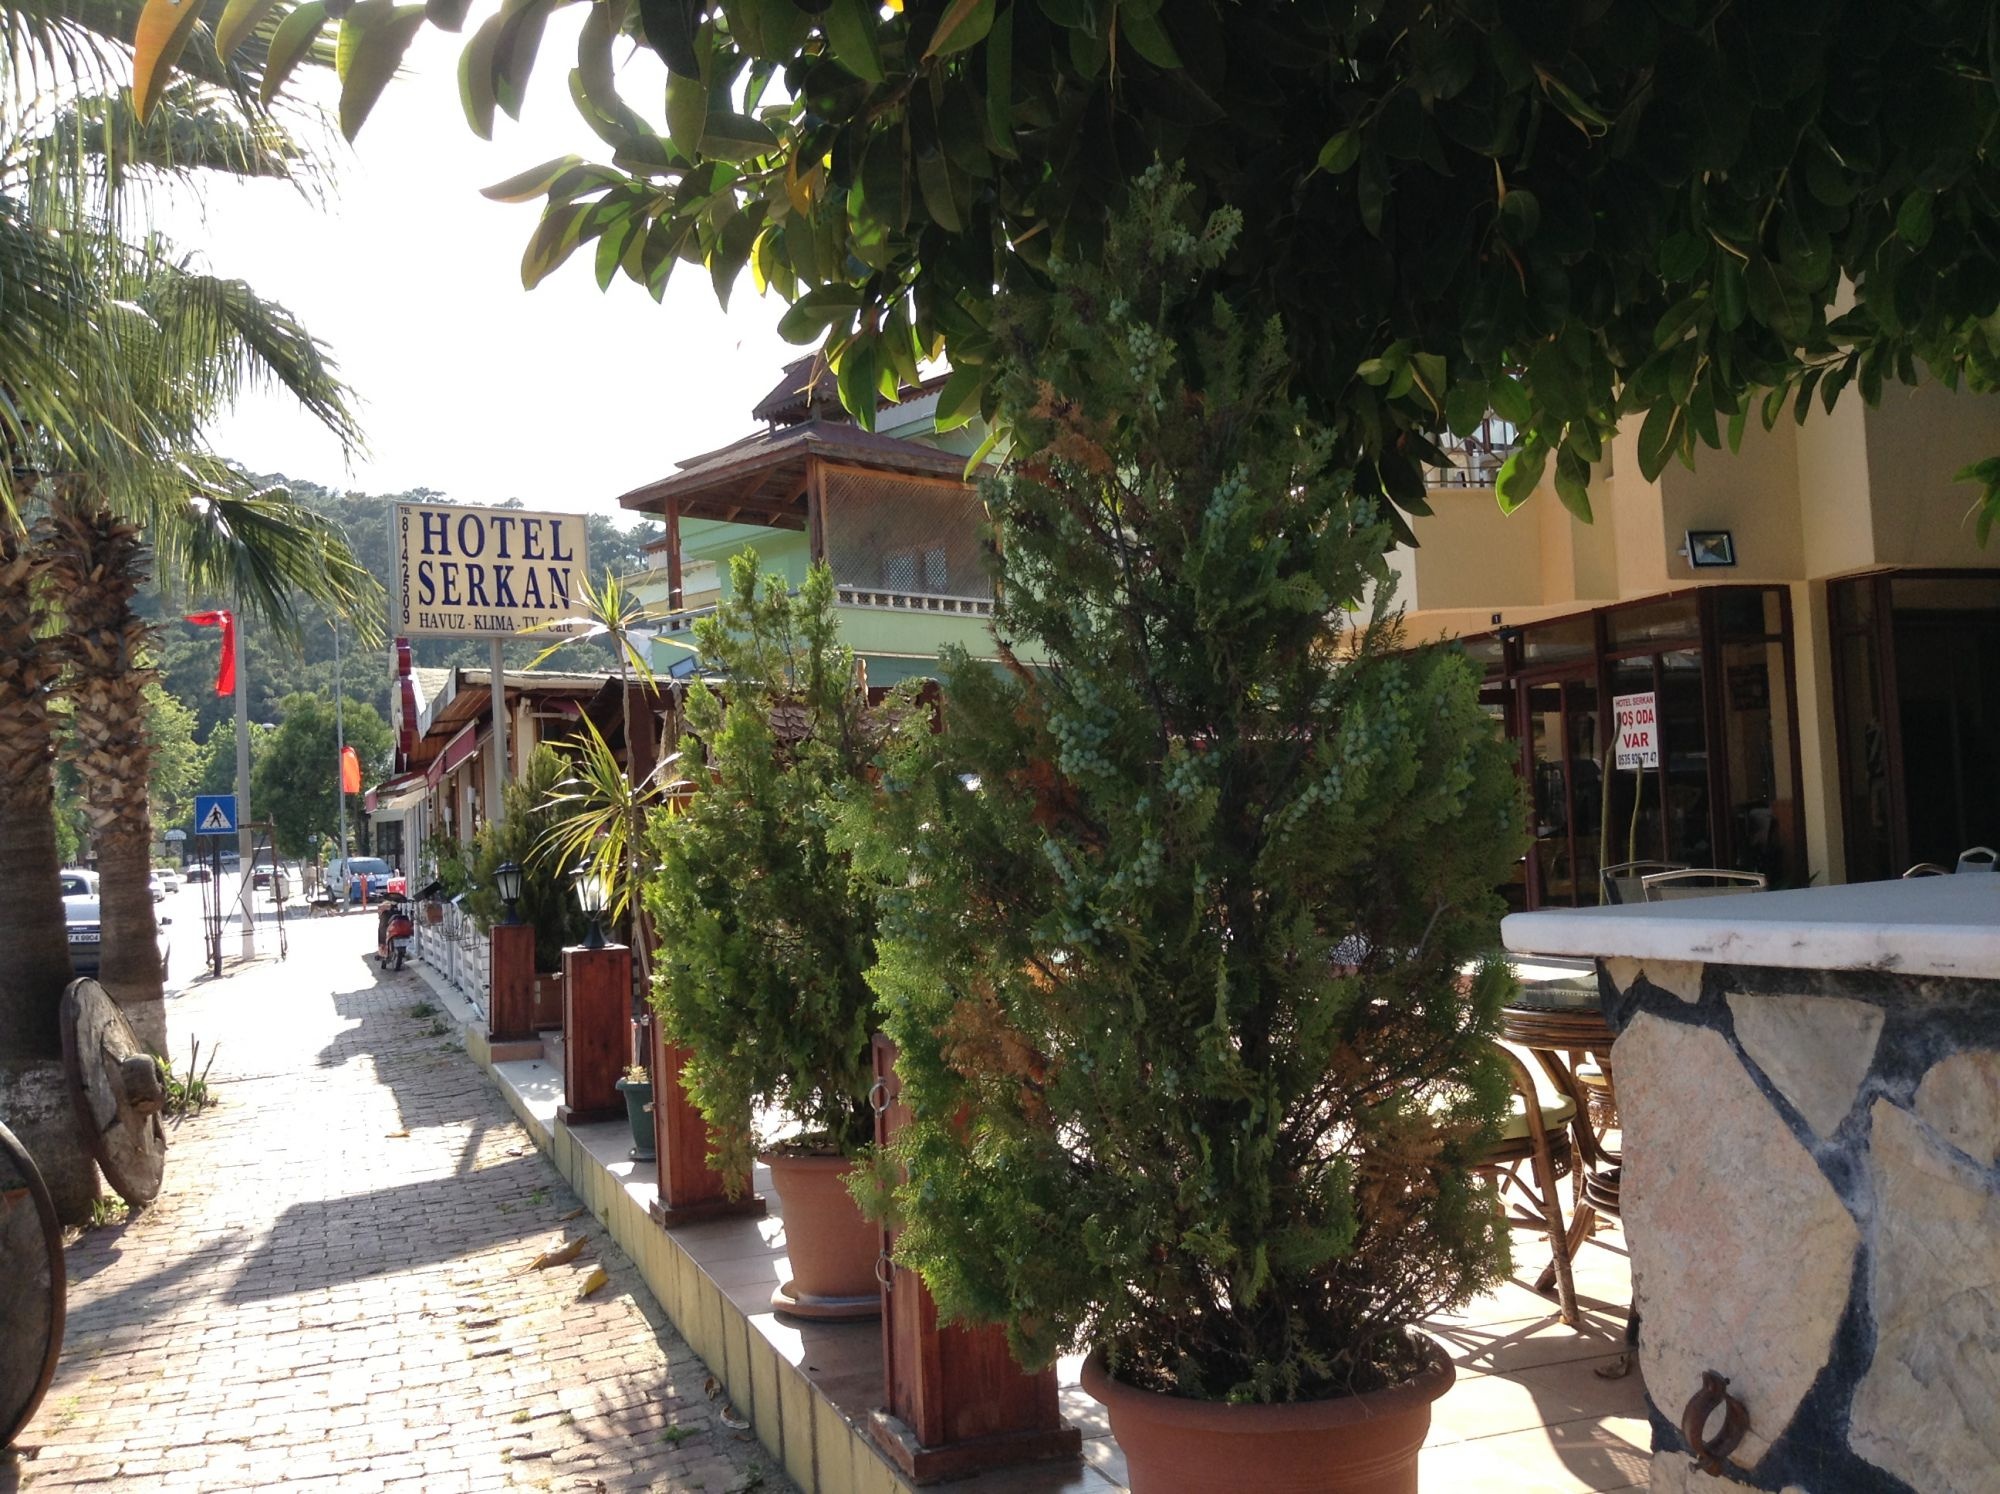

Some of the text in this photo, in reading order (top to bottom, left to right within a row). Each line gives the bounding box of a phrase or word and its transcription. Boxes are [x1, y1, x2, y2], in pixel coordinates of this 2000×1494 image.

[400, 506, 412, 515] TEL
[419, 511, 573, 561] HOTEL
[401, 516, 410, 624] 8142509
[418, 560, 571, 609] SERKAN
[419, 612, 465, 630] HAVUZ
[473, 614, 514, 631] KLIMA
[1616, 695, 1654, 707] HOTEL SERKAN
[1636, 708, 1654, 725] ODA
[1623, 732, 1649, 748] VAR
